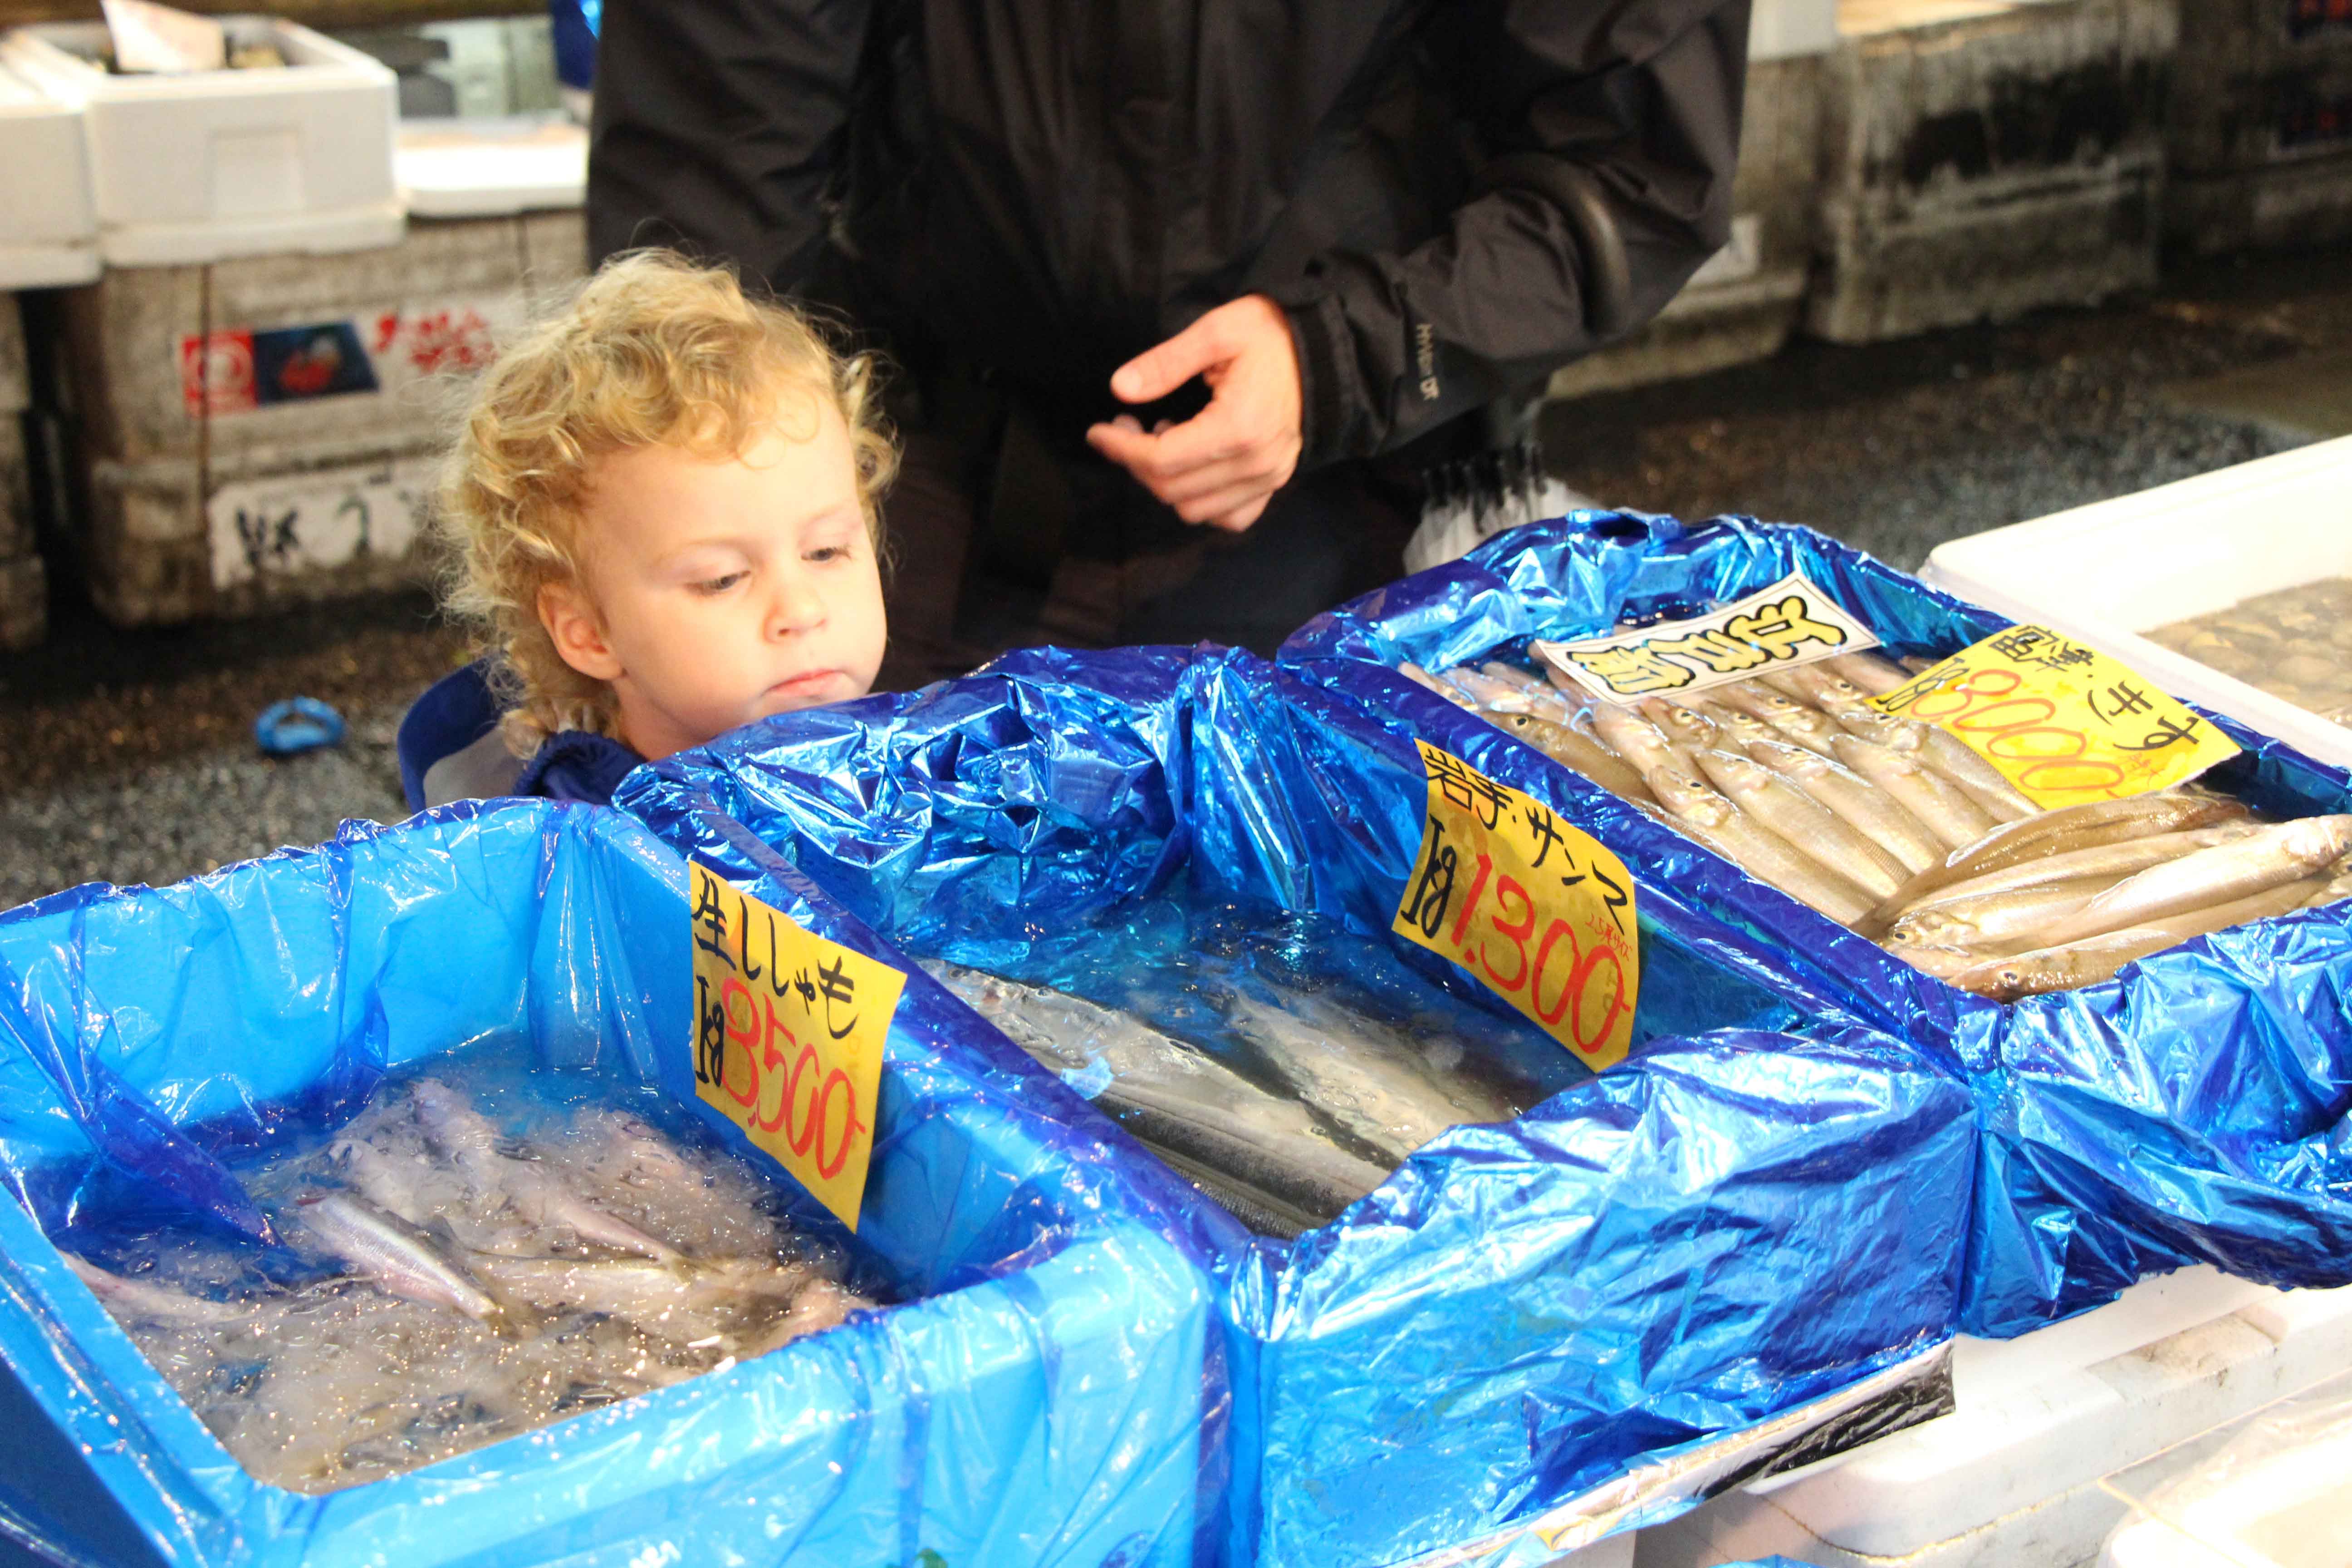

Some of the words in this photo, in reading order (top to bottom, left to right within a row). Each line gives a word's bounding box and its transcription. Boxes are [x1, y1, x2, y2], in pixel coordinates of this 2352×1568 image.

[691, 868, 859, 1039] 生ししゃも
